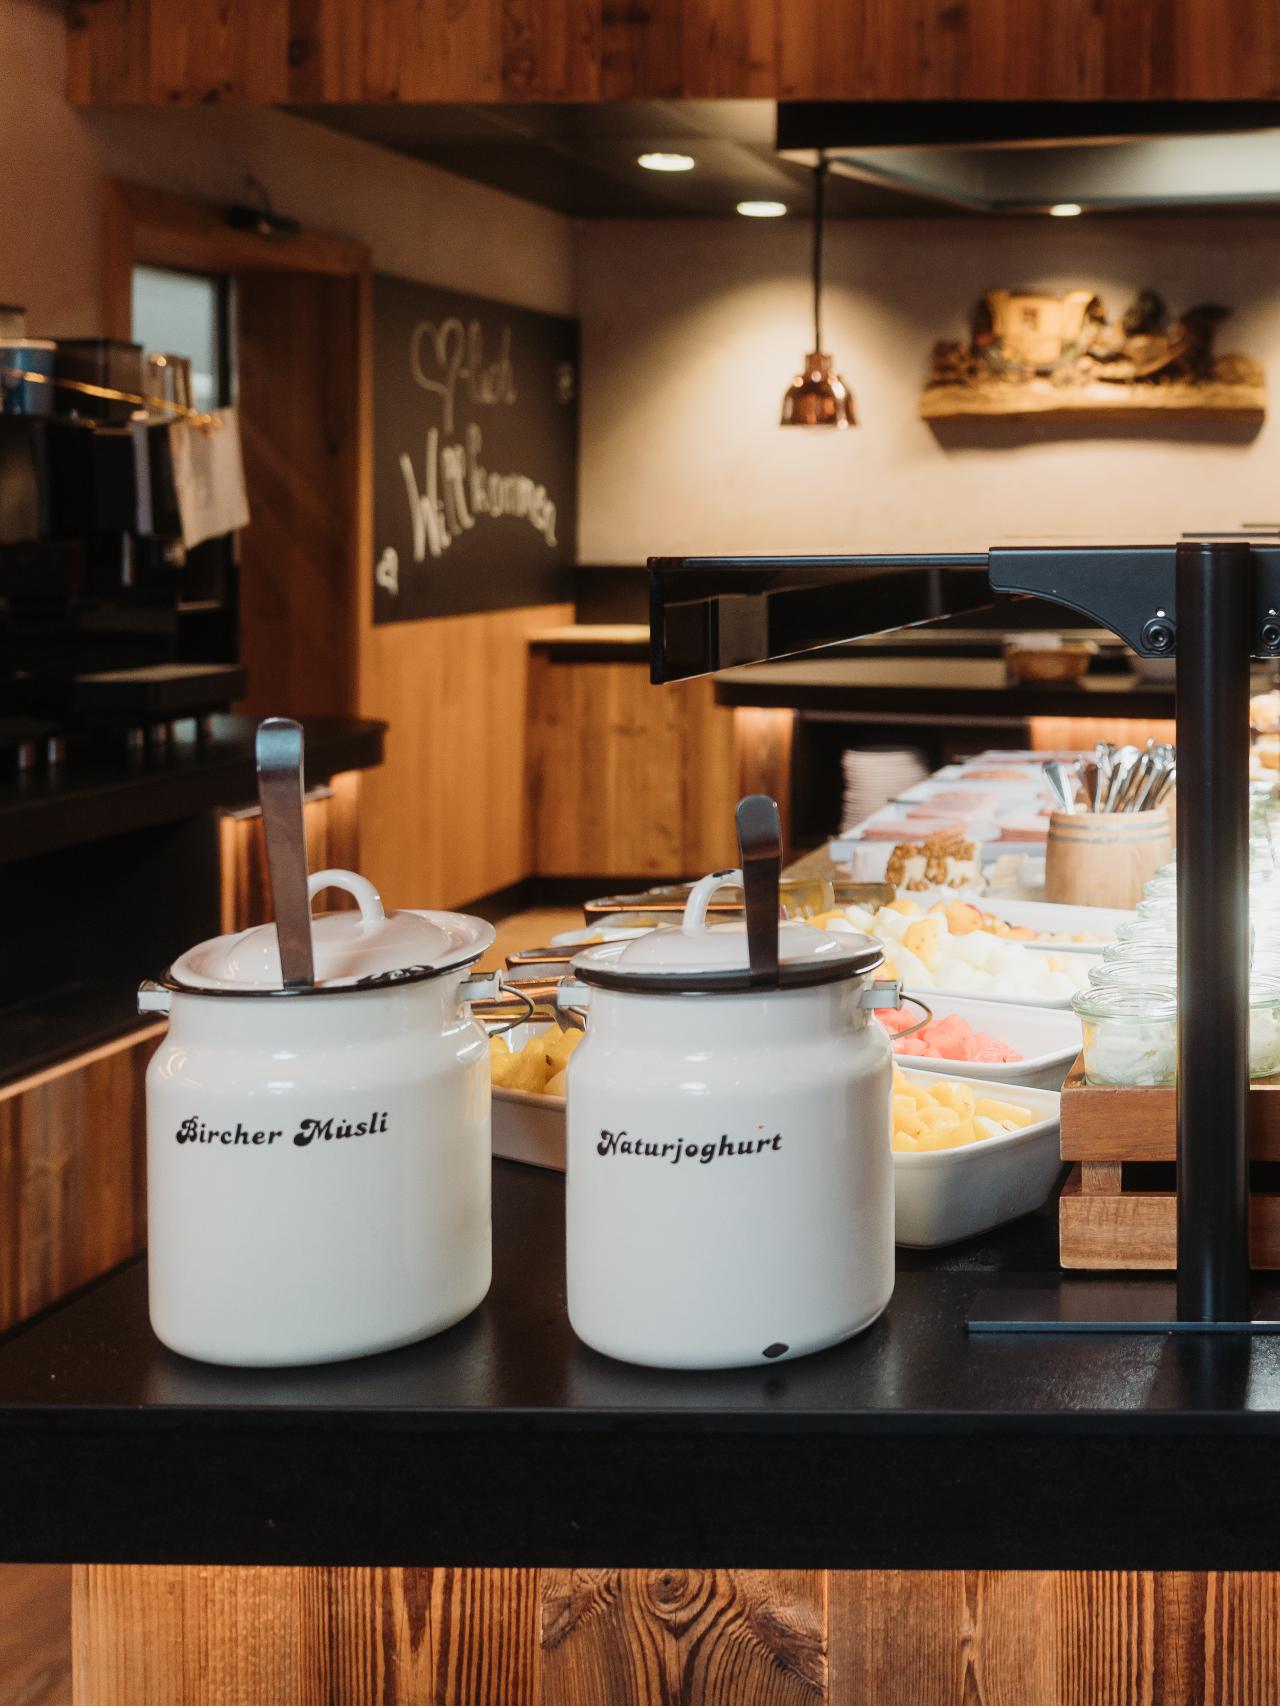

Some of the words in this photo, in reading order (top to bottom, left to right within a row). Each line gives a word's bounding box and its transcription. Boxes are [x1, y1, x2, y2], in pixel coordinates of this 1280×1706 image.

[176, 1115, 283, 1145] Bircher
[293, 1112, 389, 1147] Müsli
[596, 1129, 783, 1164] Naturjoghurt
